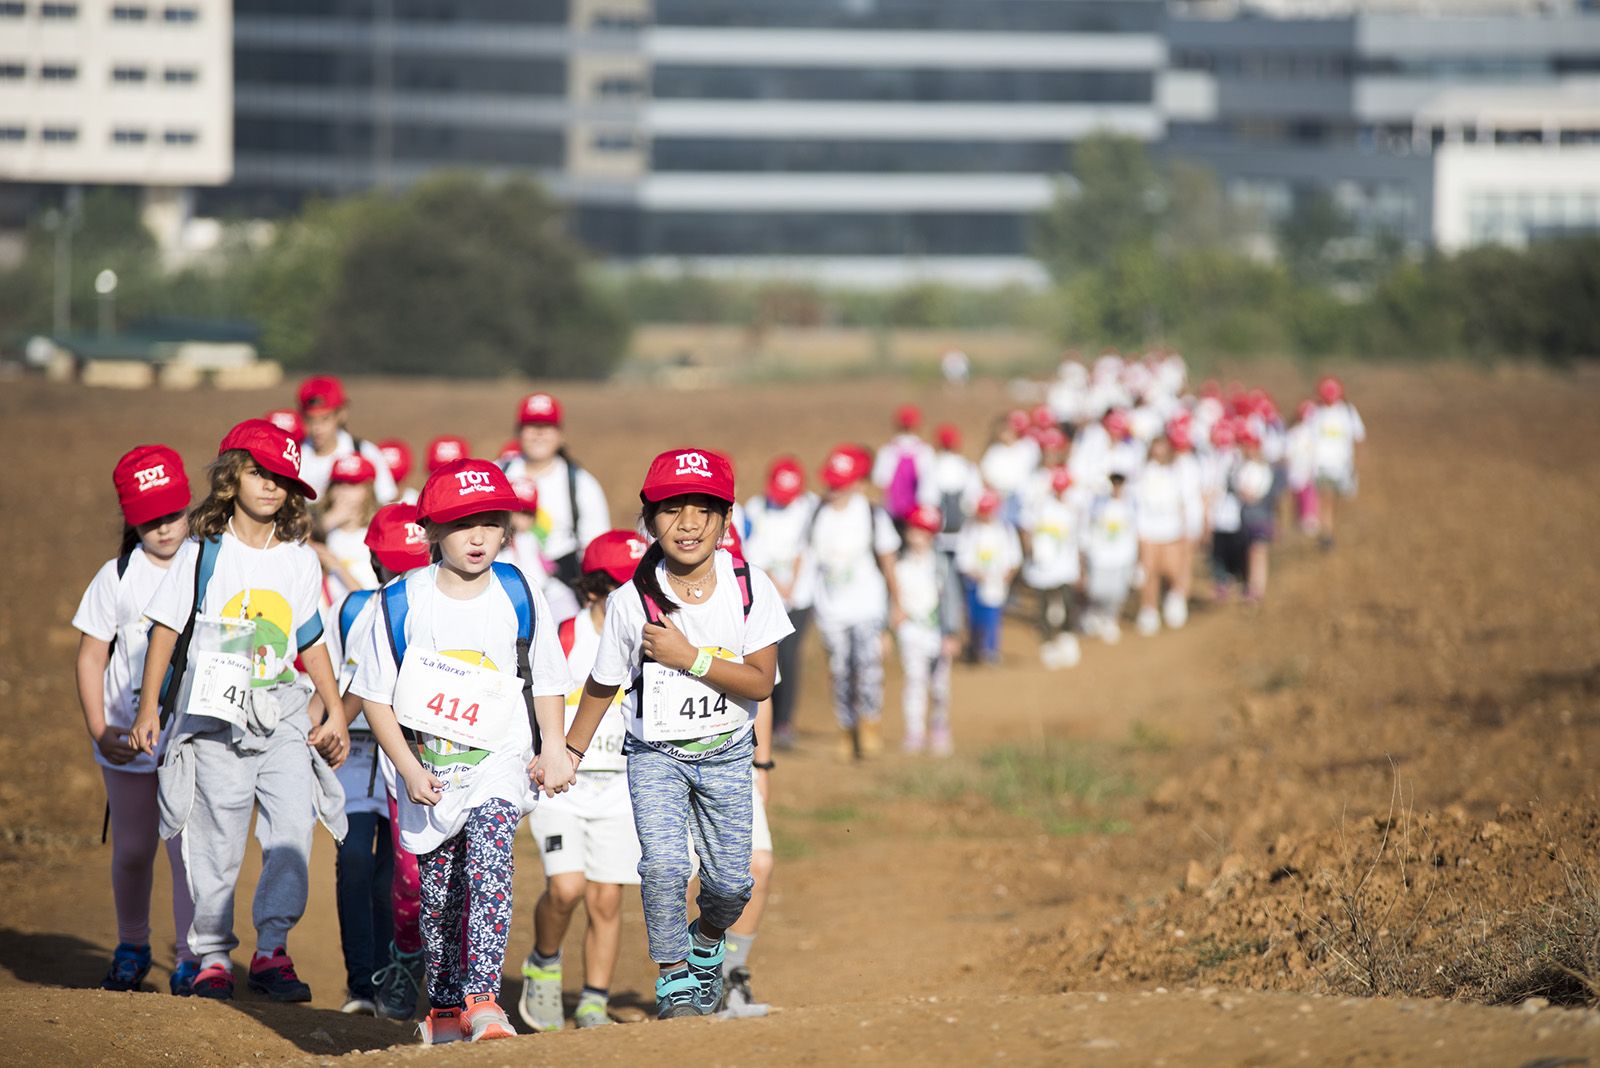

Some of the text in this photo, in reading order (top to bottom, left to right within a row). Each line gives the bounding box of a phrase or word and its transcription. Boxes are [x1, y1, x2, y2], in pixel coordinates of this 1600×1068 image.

[675, 452, 709, 470] TOT
[134, 464, 165, 485] TOT
[454, 470, 490, 488] TOT
[426, 692, 480, 727] 414
[679, 692, 728, 720] 414
[667, 747, 702, 759] Marxa
